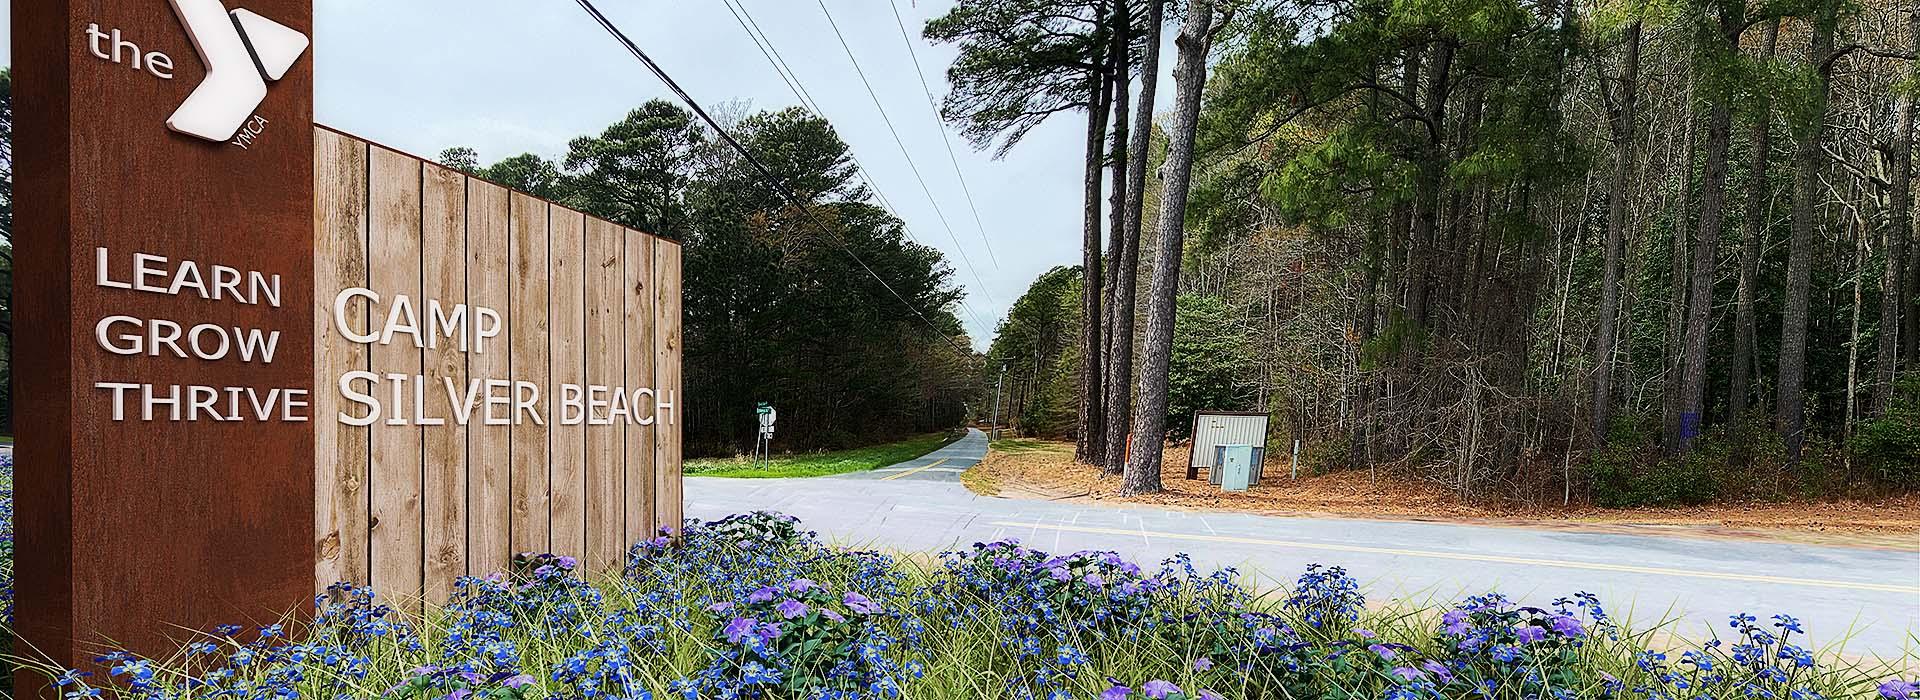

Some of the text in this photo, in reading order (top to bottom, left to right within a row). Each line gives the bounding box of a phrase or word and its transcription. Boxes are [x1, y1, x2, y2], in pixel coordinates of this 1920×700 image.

[86, 22, 174, 80] the
[231, 113, 270, 151] YMCA
[96, 246, 281, 308] LEARN
[95, 315, 281, 364] GROW
[333, 286, 502, 354] CAMP
[94, 381, 309, 422] THRIVE
[337, 369, 675, 427] SILVER BEACH
